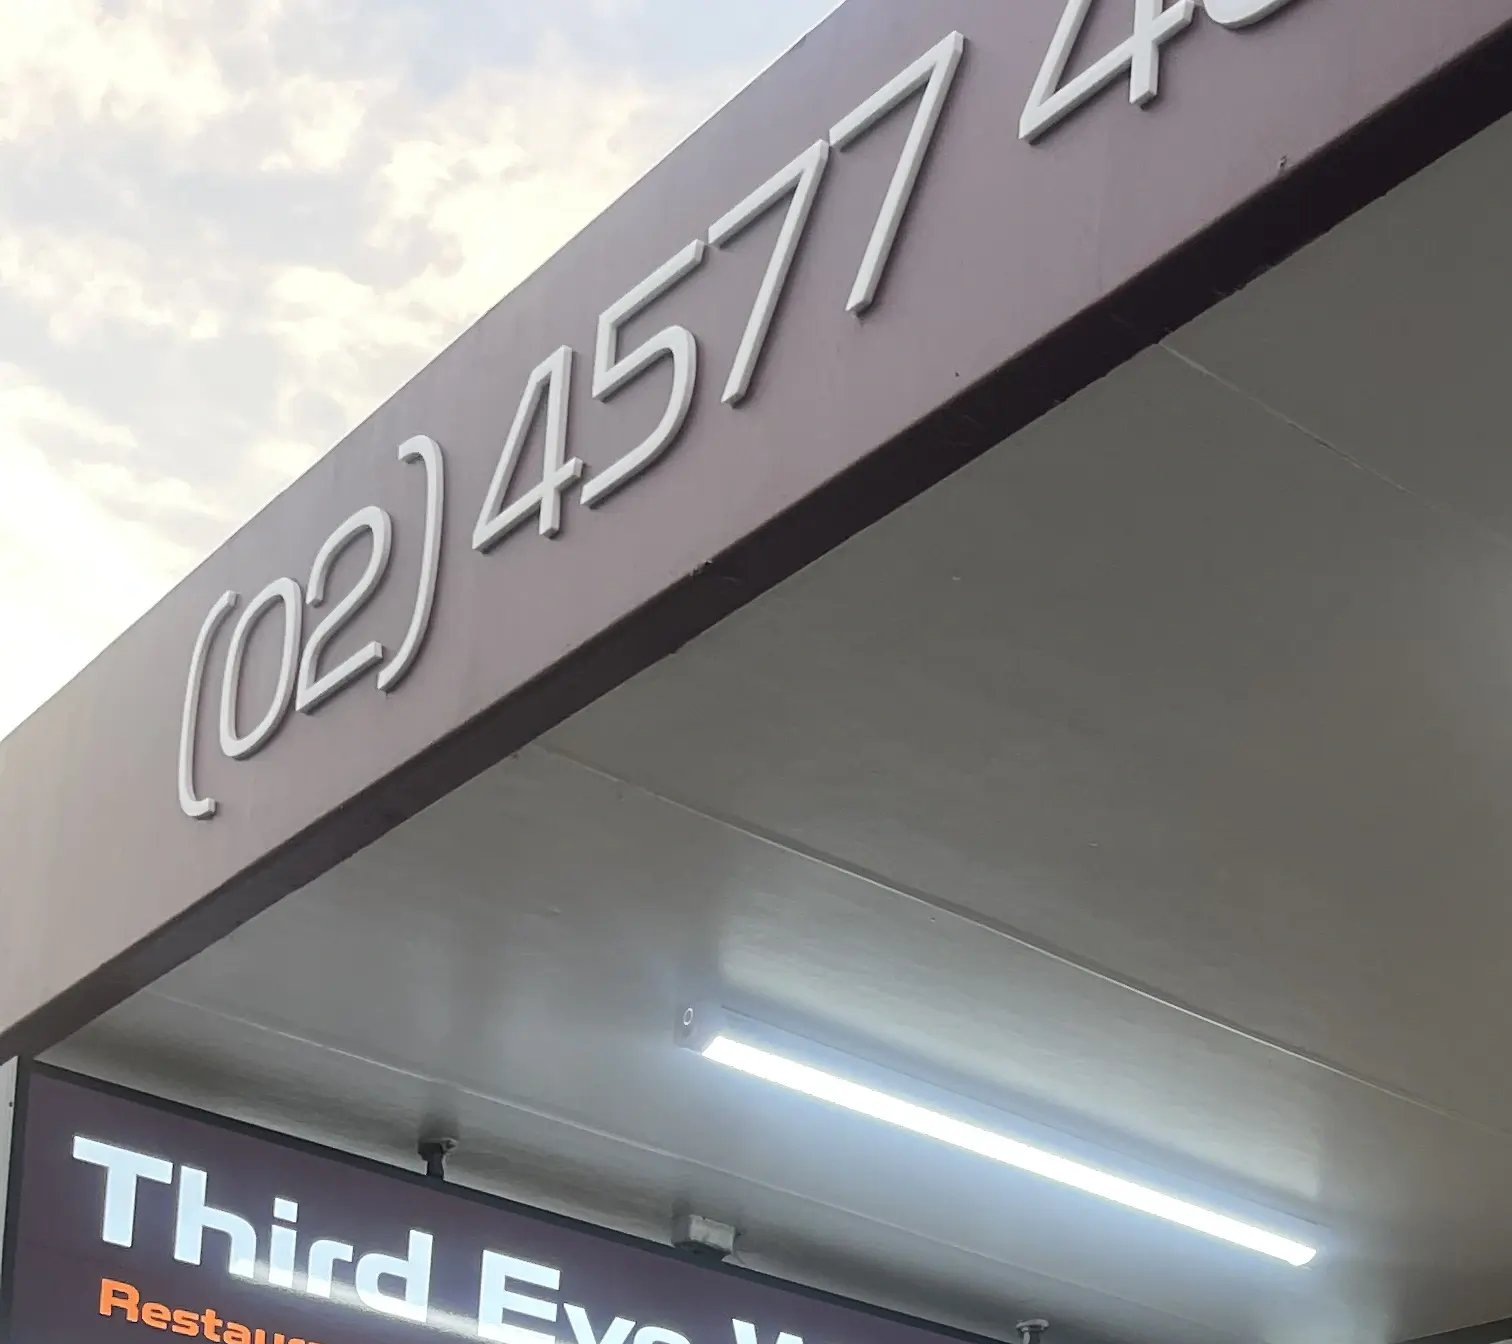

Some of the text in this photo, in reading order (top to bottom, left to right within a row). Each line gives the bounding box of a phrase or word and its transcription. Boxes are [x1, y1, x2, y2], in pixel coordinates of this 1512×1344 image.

[178, 0, 1300, 818] (02) 4577 4
[72, 1135, 434, 1324] Third
